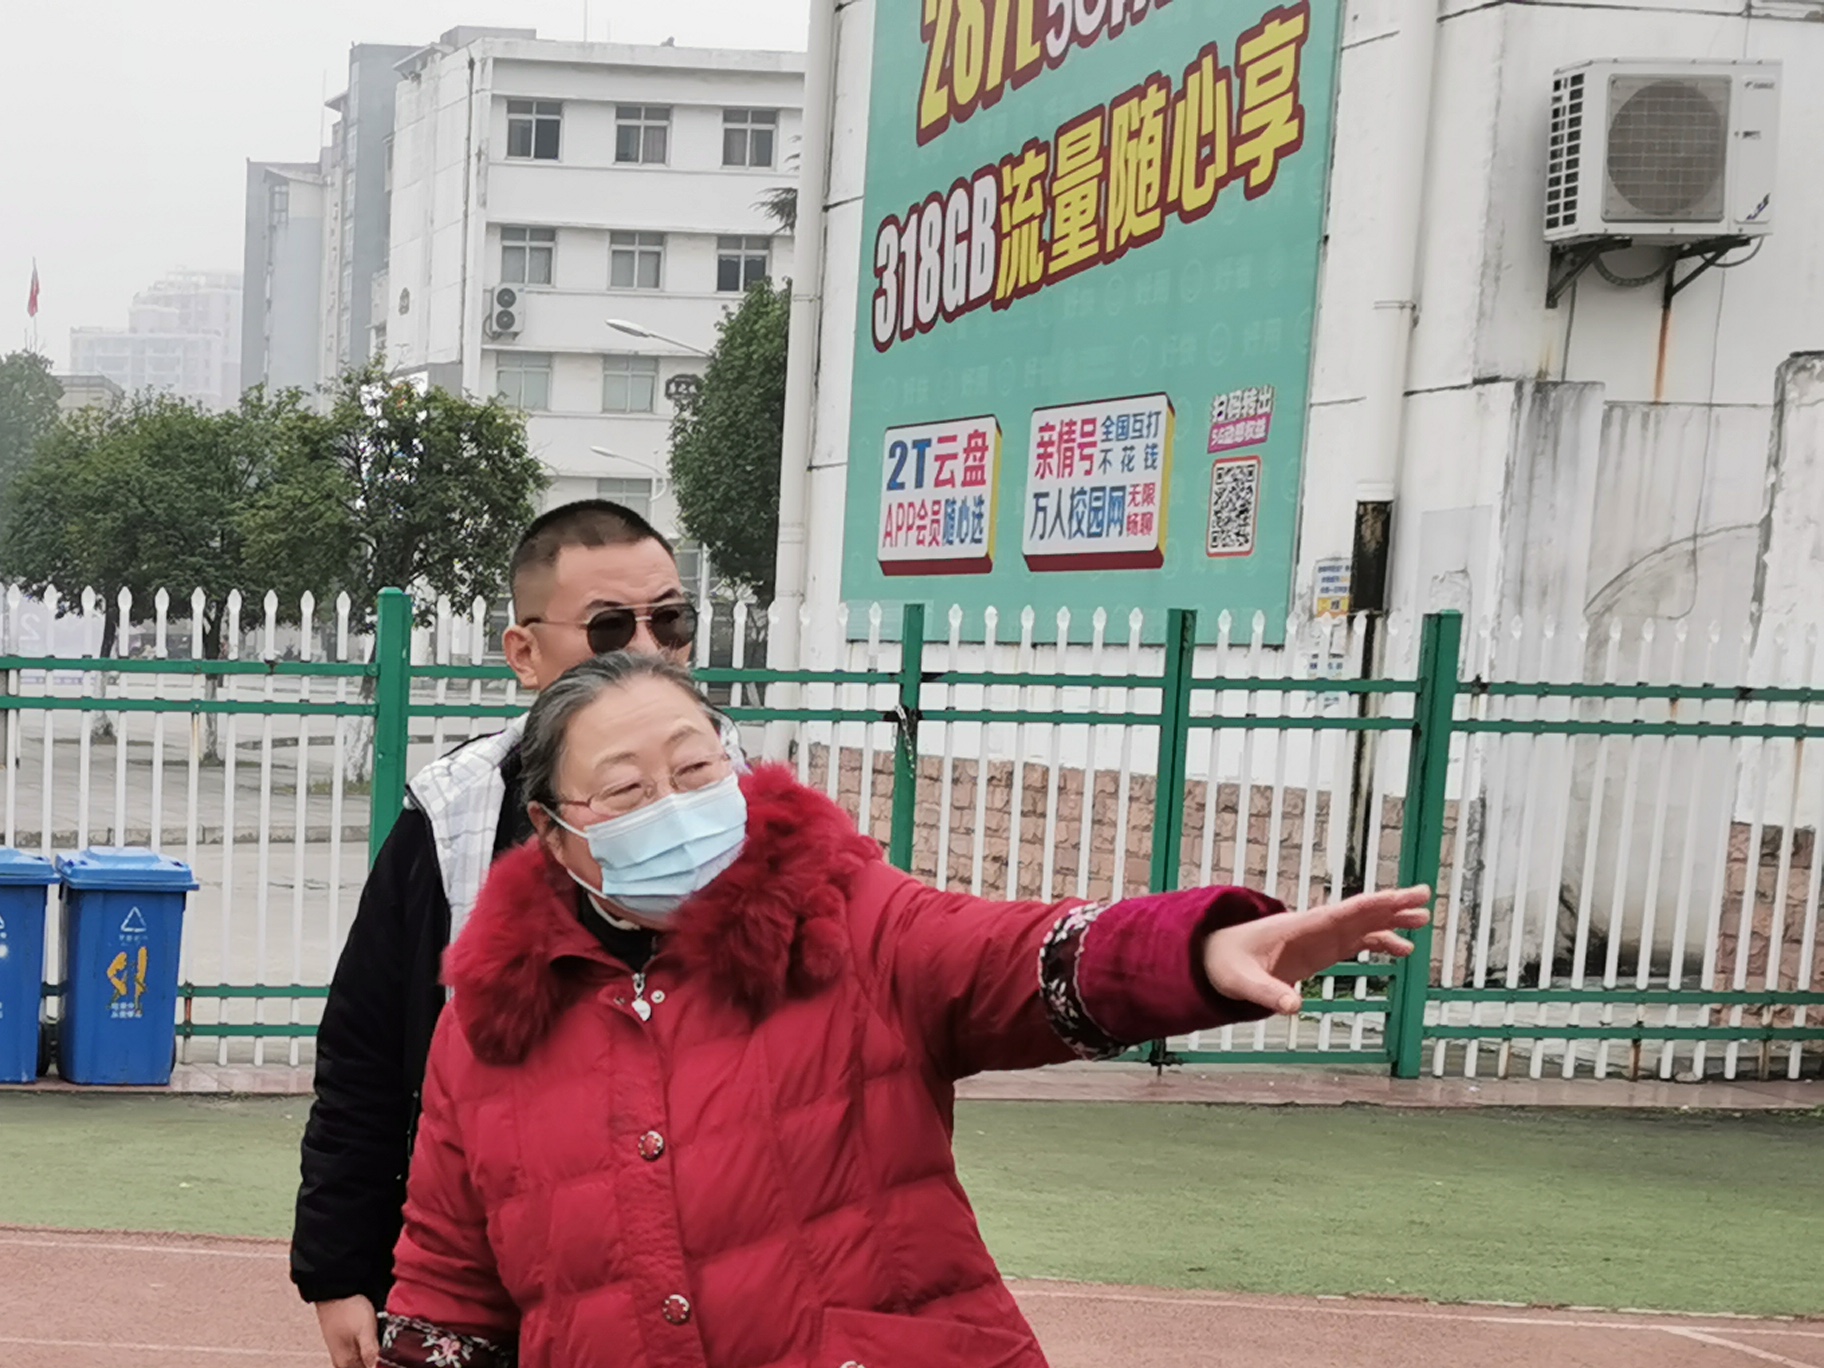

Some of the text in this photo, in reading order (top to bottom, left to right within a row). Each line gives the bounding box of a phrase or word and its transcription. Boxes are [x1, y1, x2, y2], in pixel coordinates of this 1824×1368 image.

[875, 13, 1304, 344] 318GB流量随心享
[1034, 417, 1097, 480] 亲情号
[1101, 410, 1162, 442] 全国互打
[886, 429, 989, 491] 2T云盘
[1098, 443, 1159, 475] 不花钱
[882, 494, 985, 547] APP会员随心选
[1030, 485, 1127, 541] 万人校园网
[1128, 482, 1156, 507] 无限
